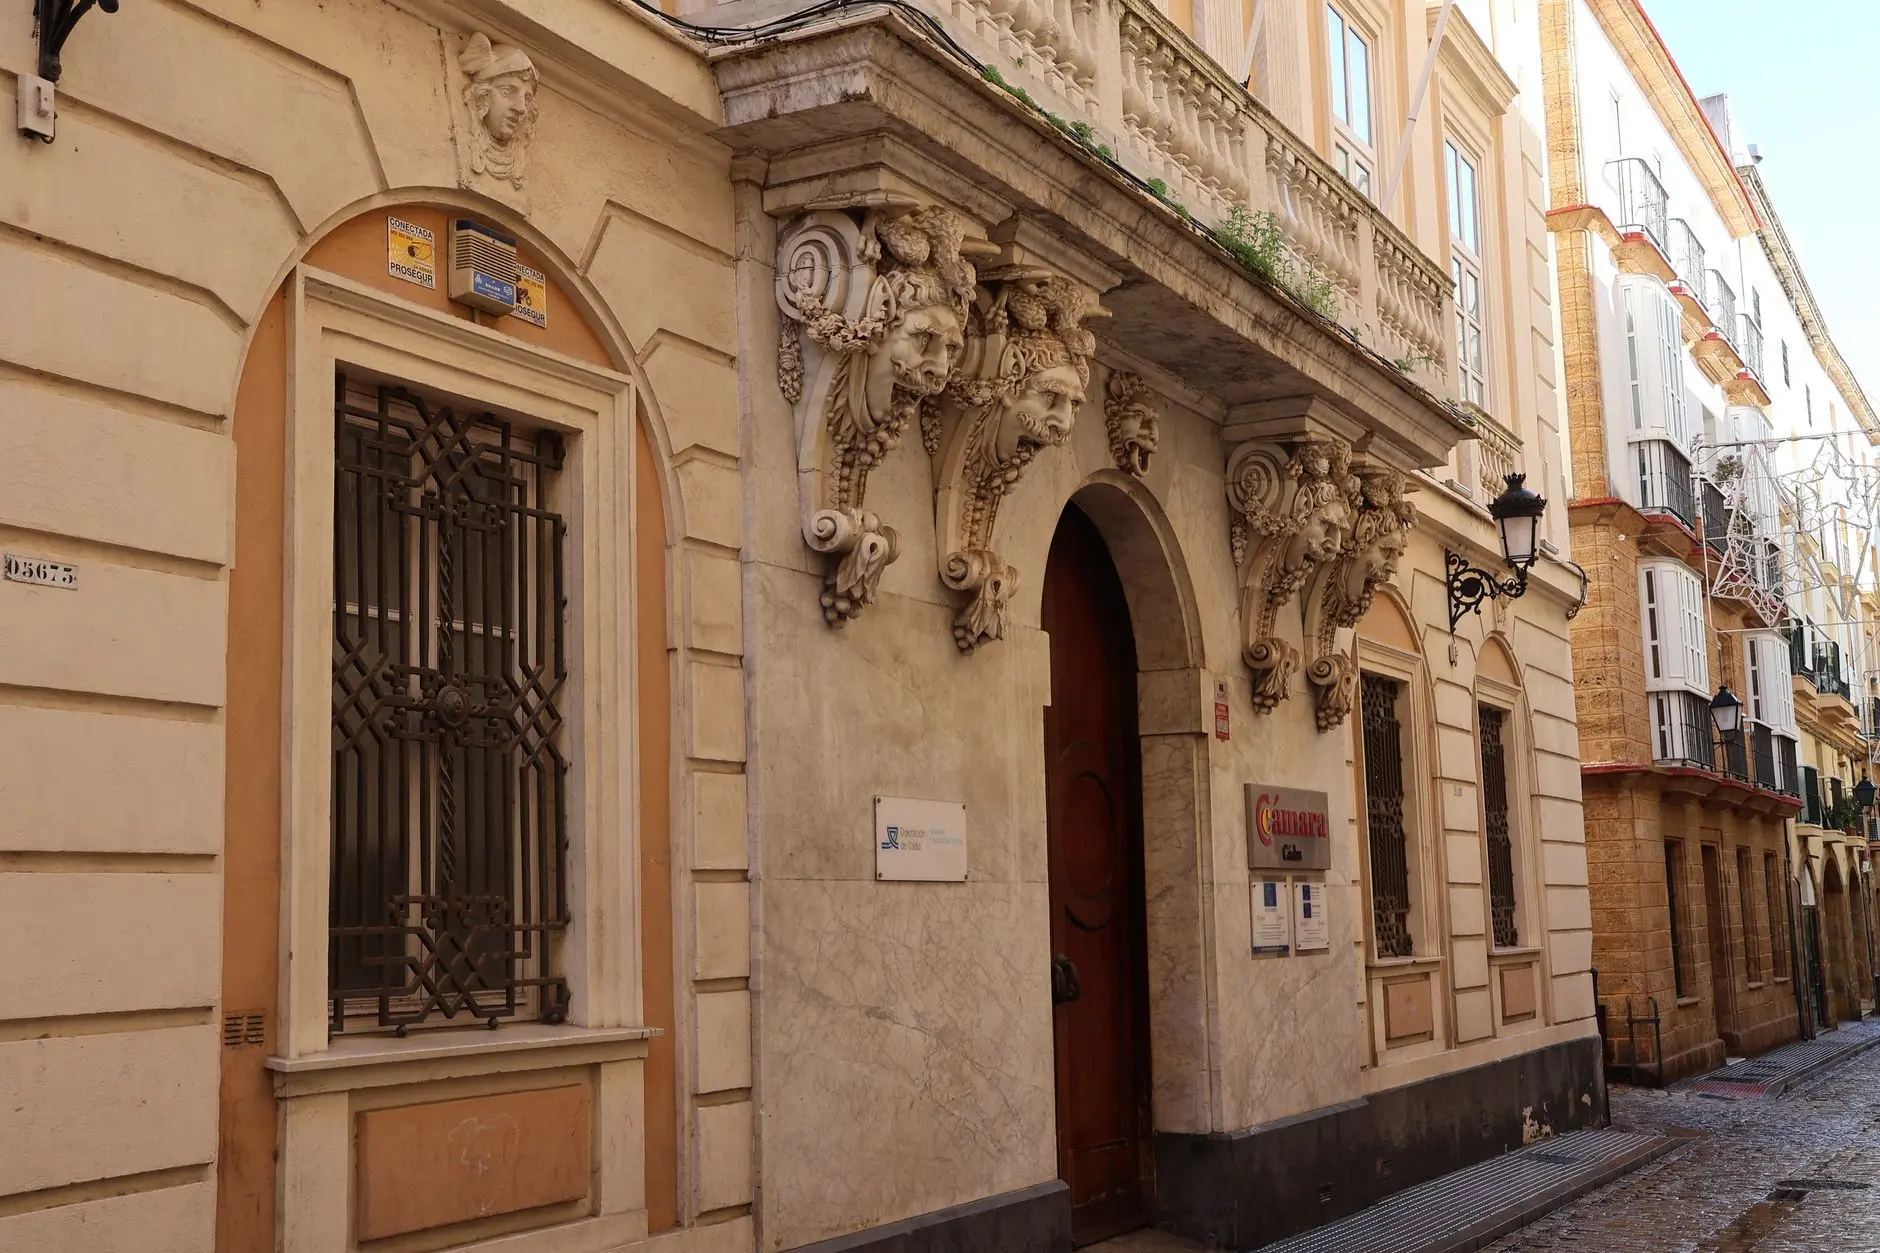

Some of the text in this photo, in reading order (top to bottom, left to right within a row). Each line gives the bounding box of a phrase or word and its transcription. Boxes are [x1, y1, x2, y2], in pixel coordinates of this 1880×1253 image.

[389, 217, 433, 239] CONECTADA
[390, 262, 433, 283] PROSEGUR
[517, 264, 544, 280] NECTADA
[515, 304, 545, 322] OSEGUR
